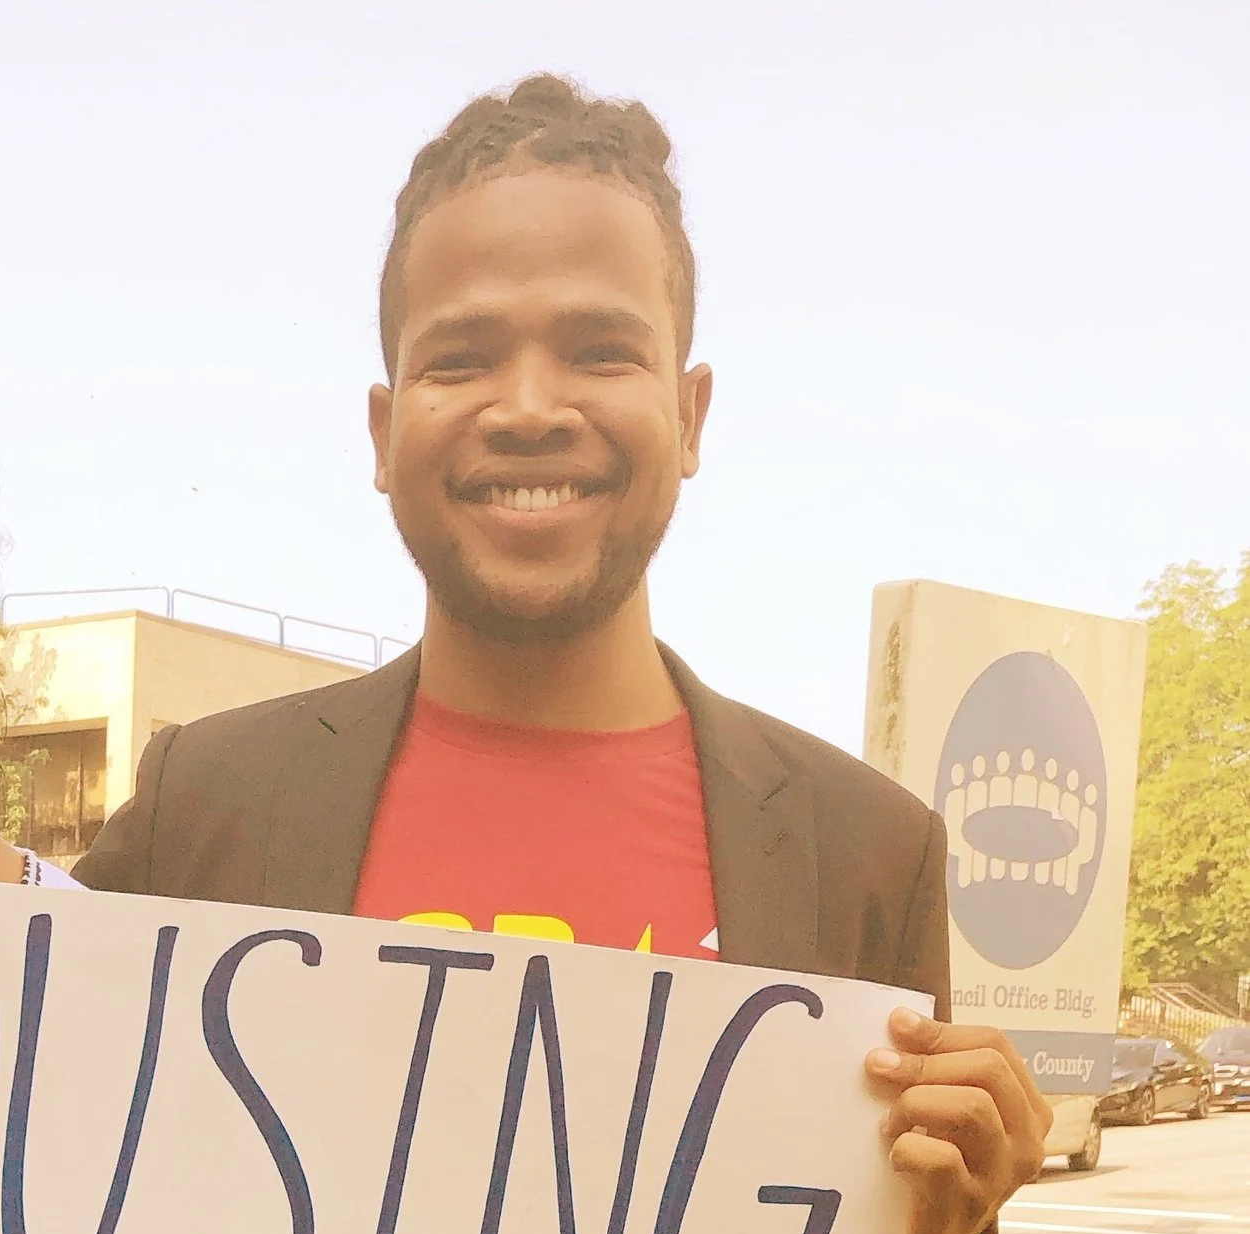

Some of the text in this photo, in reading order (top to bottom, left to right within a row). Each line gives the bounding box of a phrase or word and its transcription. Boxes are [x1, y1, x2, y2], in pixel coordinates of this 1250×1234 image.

[952, 984, 1098, 1020] ncil Office Bldg.
[1033, 1050, 1095, 1083] County
